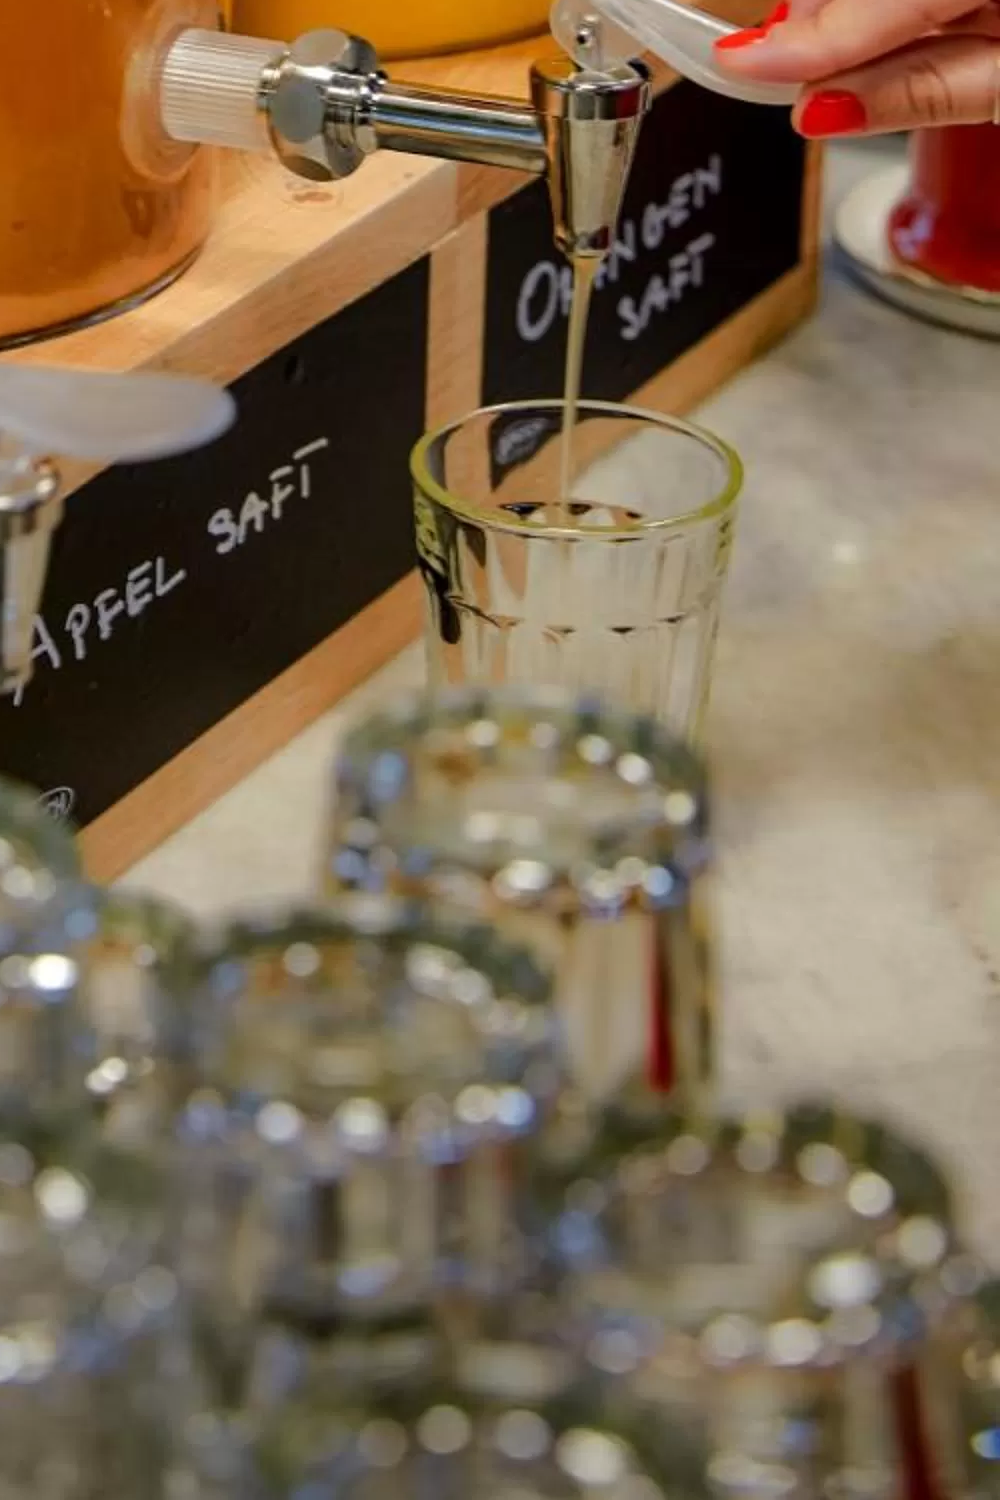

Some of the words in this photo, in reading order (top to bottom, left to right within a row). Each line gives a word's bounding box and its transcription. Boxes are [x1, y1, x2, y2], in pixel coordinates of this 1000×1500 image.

[616, 233, 716, 341] SAFT
[12, 556, 187, 707] APFEL
[207, 437, 329, 554] SAFT
